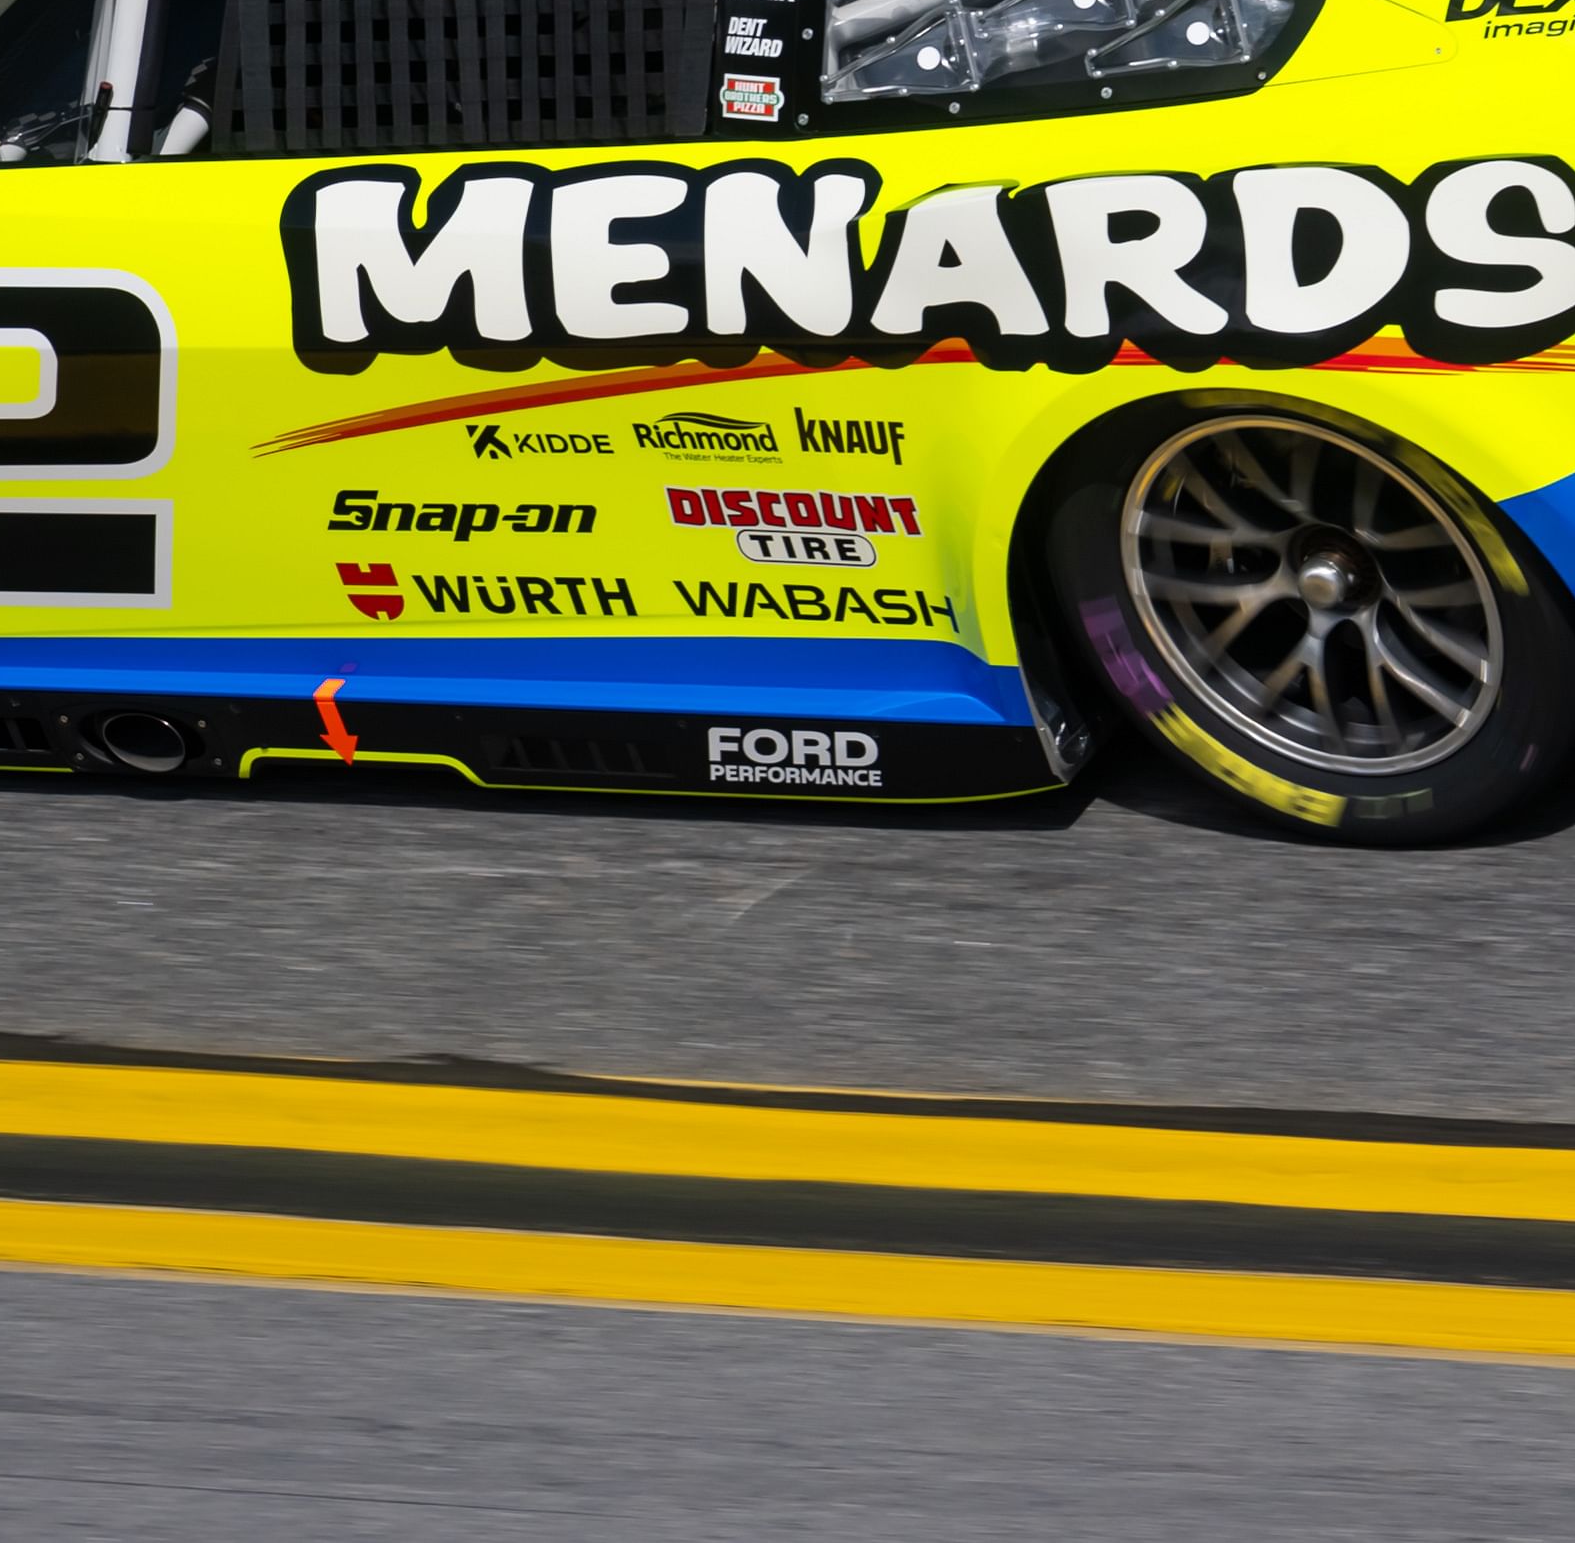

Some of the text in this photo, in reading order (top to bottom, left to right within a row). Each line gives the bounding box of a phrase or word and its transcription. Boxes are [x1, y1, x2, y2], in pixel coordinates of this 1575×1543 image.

[728, 16, 767, 37] DENT
[725, 36, 783, 57] WIZARD
[514, 433, 614, 455] KIDDE
[632, 421, 779, 453] Richmond
[794, 406, 905, 466] KNAUF
[327, 490, 598, 542] Snap-on
[666, 486, 922, 536] DISCOUNT
[749, 534, 862, 563] TIRE
[412, 574, 638, 616] WÜRTH
[673, 579, 960, 634] WABASH
[708, 727, 879, 768] FORD
[710, 764, 883, 787] PERFORMANCE
